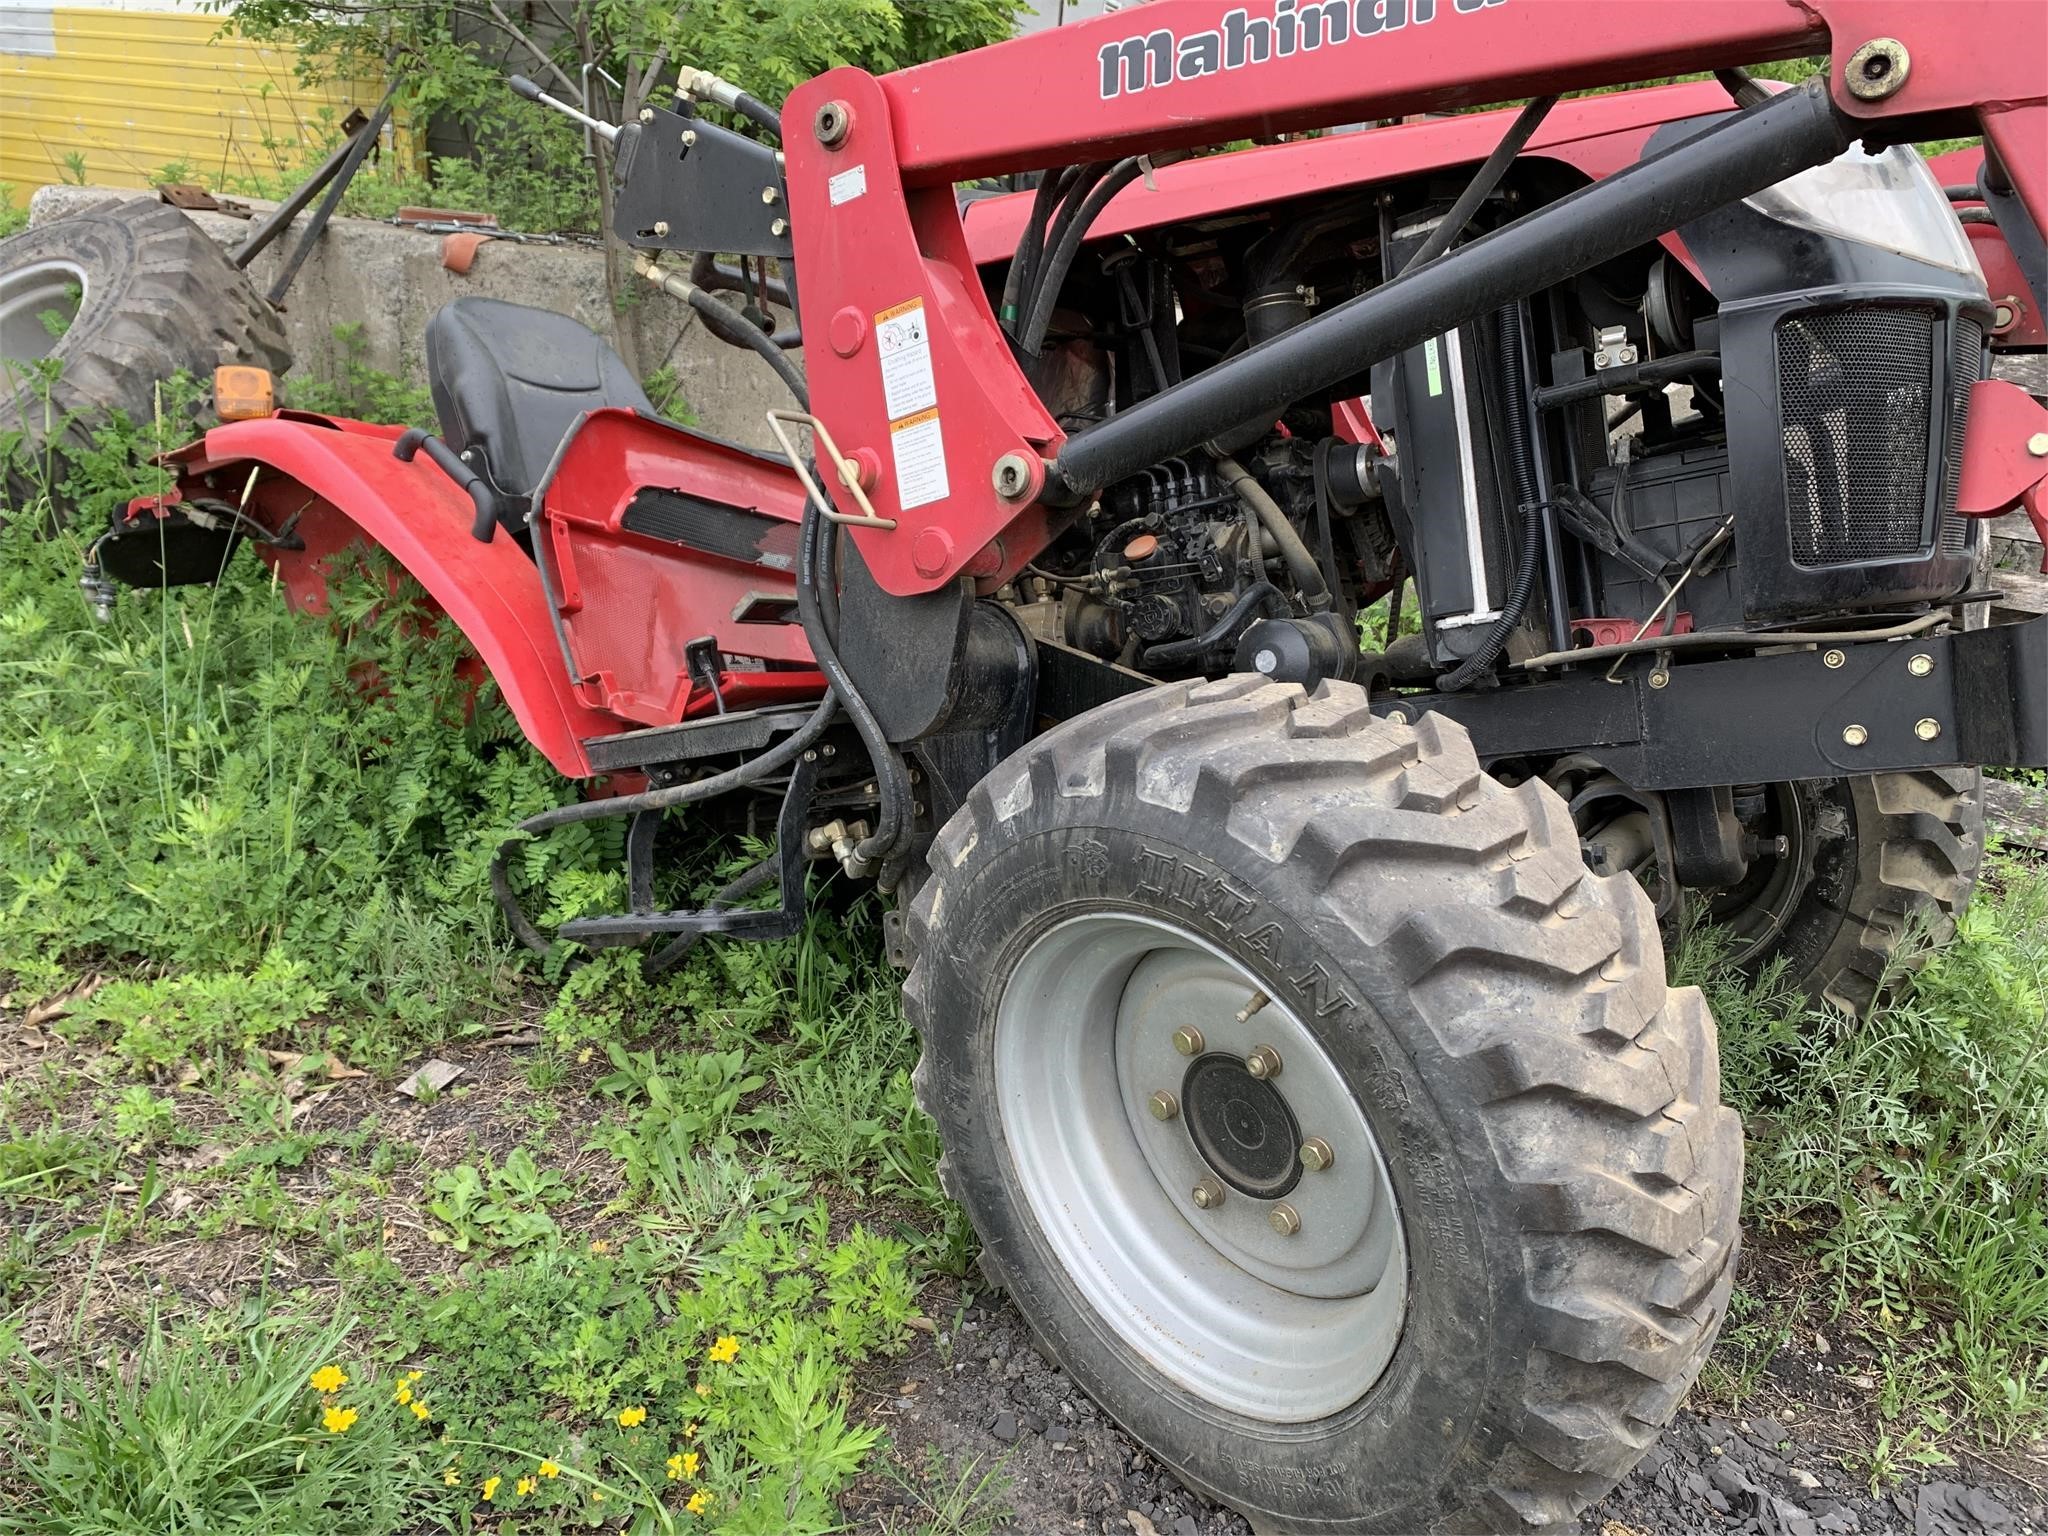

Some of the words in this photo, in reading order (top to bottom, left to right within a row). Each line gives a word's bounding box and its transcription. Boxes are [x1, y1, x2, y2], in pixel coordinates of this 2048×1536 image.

[890, 303, 918, 317] WARNING
[904, 414, 932, 427] WARNING
[1131, 844, 1358, 1018] TITAN
